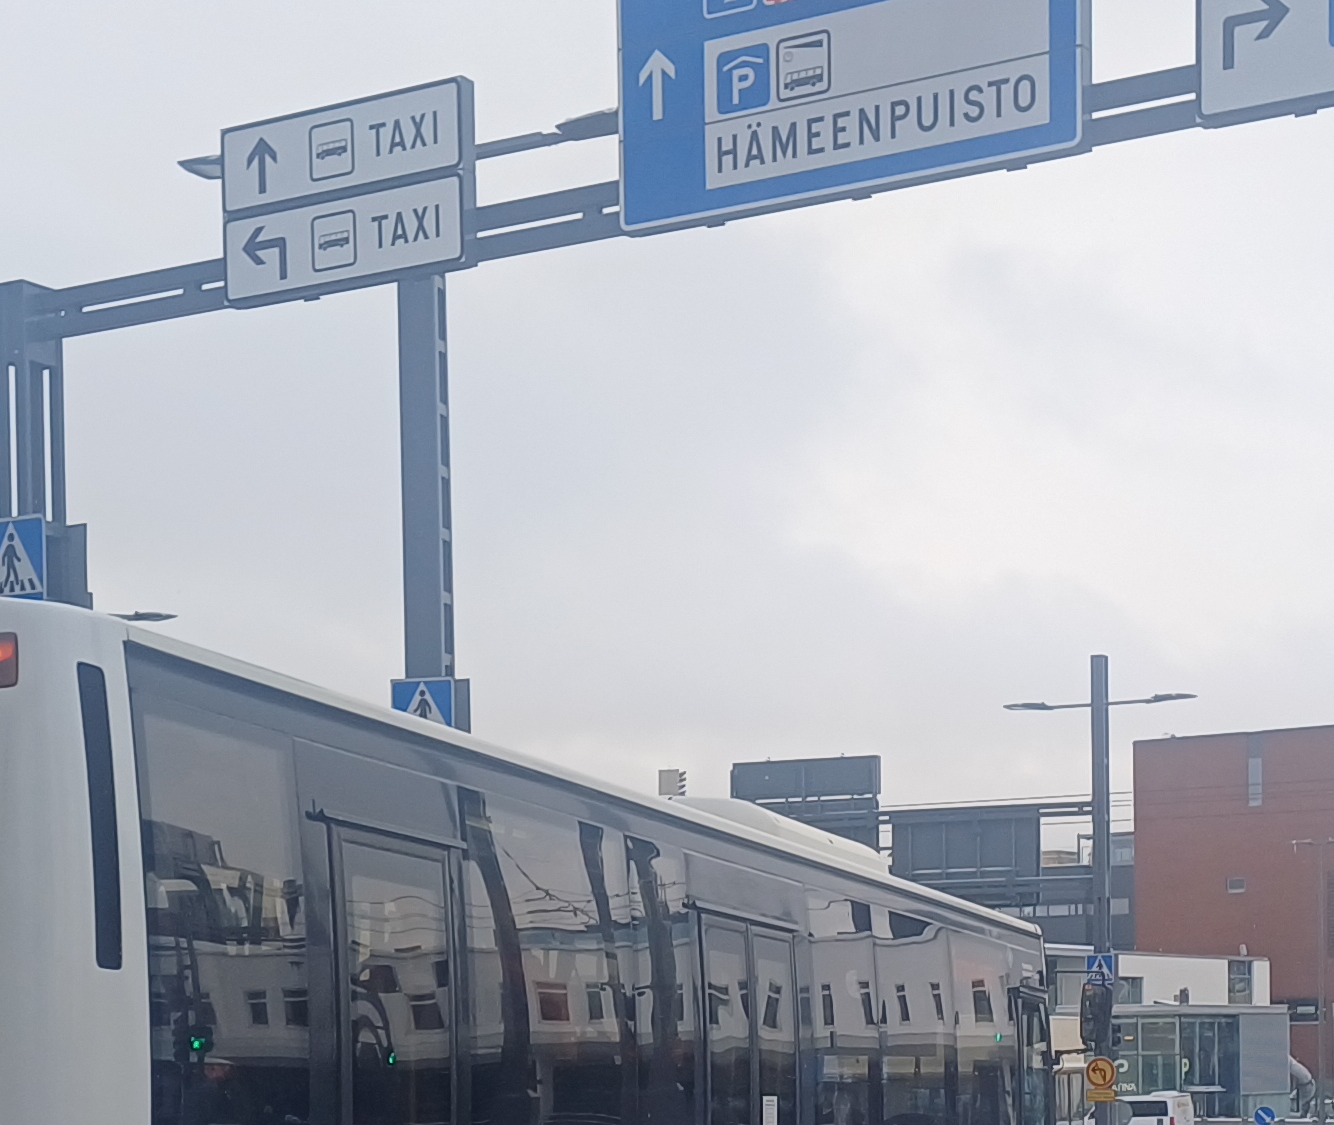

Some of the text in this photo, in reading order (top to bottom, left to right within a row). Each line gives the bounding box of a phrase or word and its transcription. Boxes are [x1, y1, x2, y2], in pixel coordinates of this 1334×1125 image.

[368, 109, 440, 158] TAXI
[716, 73, 1037, 174] HÄMEENPUISTO
[371, 203, 442, 250] TAXI
